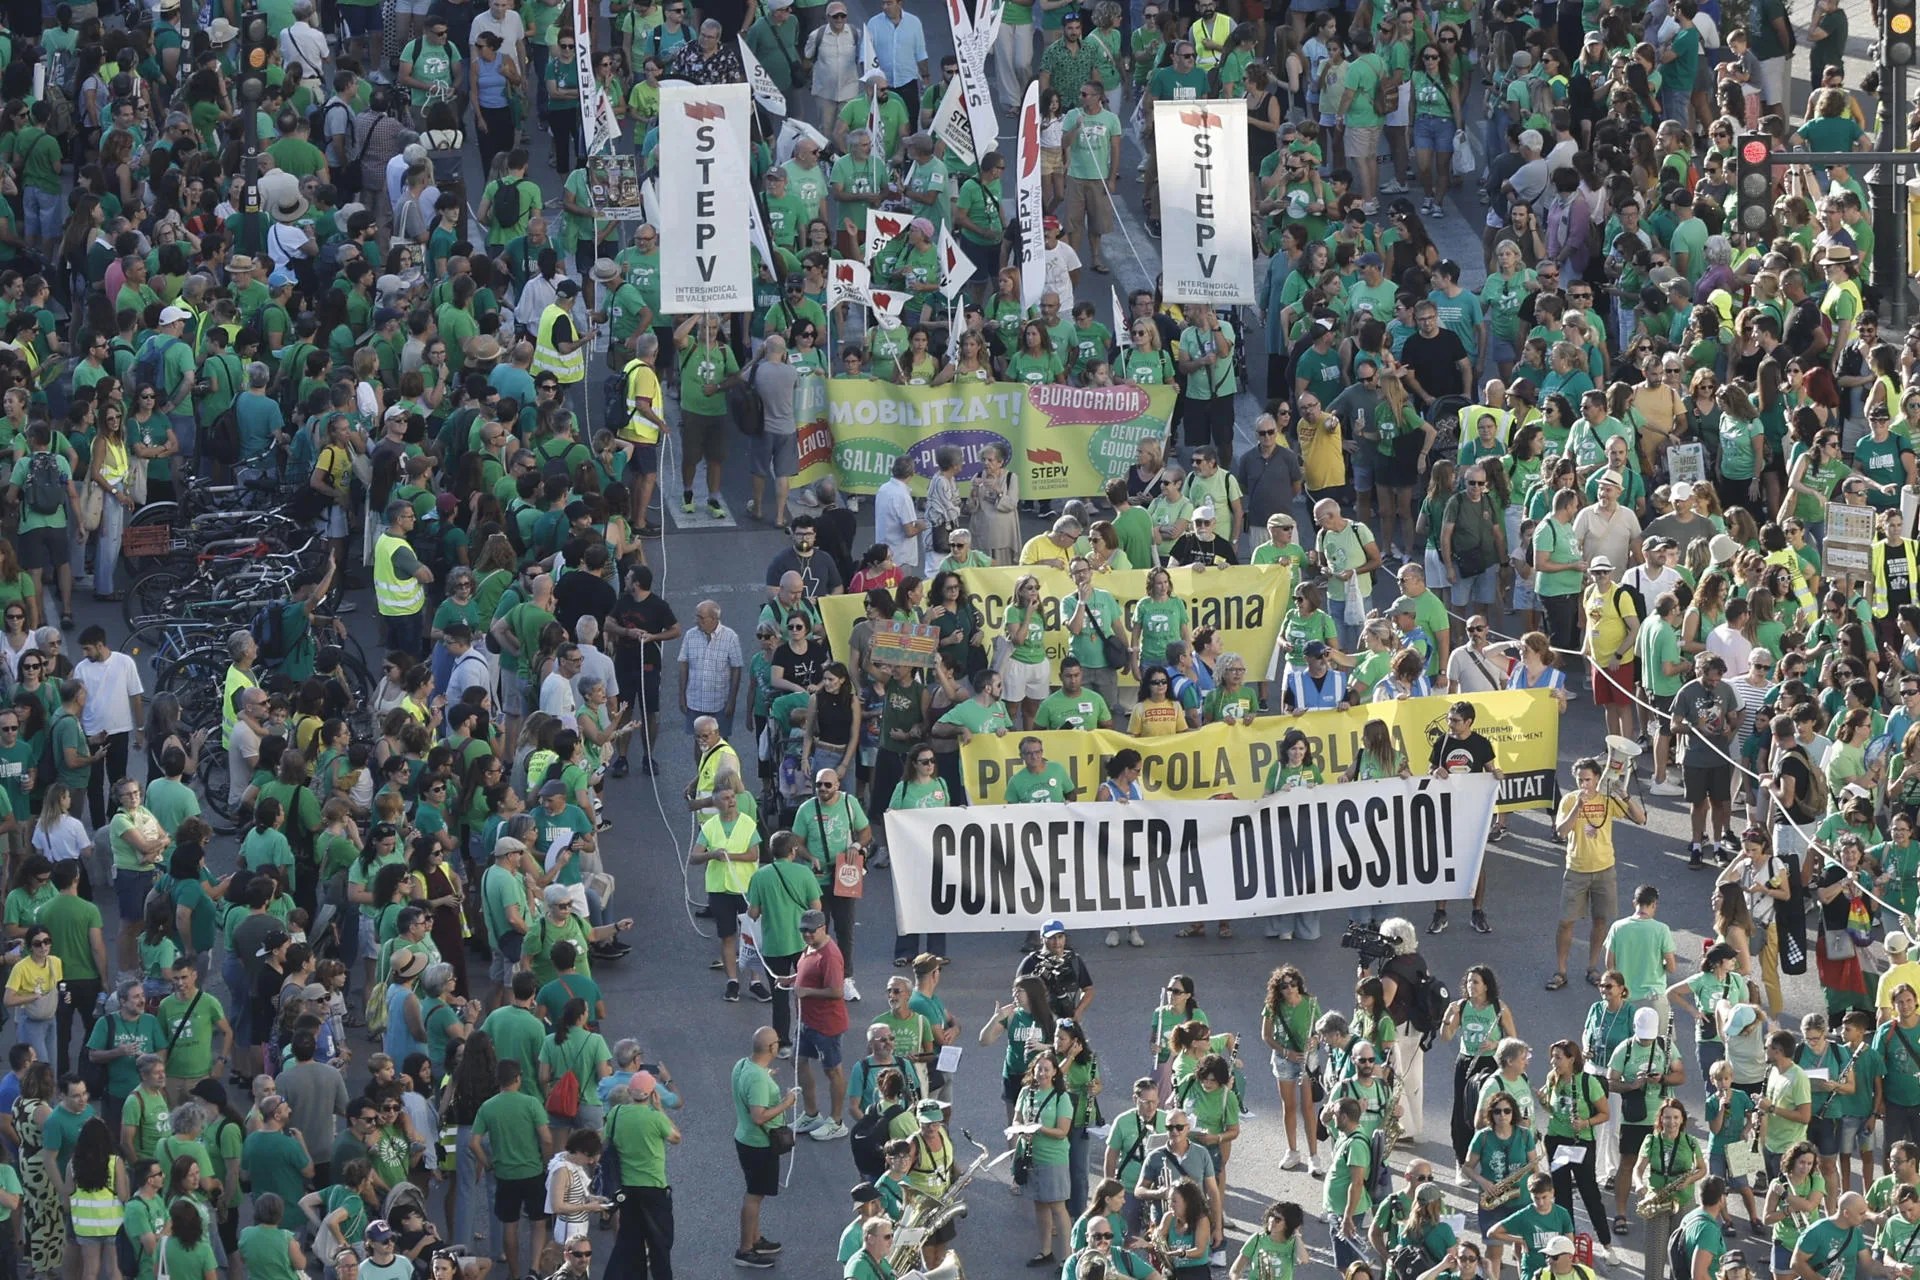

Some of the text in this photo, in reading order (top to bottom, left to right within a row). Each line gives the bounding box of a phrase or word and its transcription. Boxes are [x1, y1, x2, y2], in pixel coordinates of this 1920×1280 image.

[578, 43, 590, 118] STEPV
[696, 126, 717, 282] STEPV
[1193, 134, 1217, 278] STEPV
[1020, 188, 1032, 264] STEPV
[675, 285, 738, 294] INTERSINDICAL
[685, 292, 738, 302] VALENCIANA
[1177, 280, 1240, 290] INTERSINDICAL
[1188, 289, 1240, 297] VALENCIANA
[829, 391, 1022, 427] MOBILITZA'T!
[1032, 466, 1068, 478] STEPV
[930, 779, 1455, 915] CONSELLERA DIMISSIÓ!
